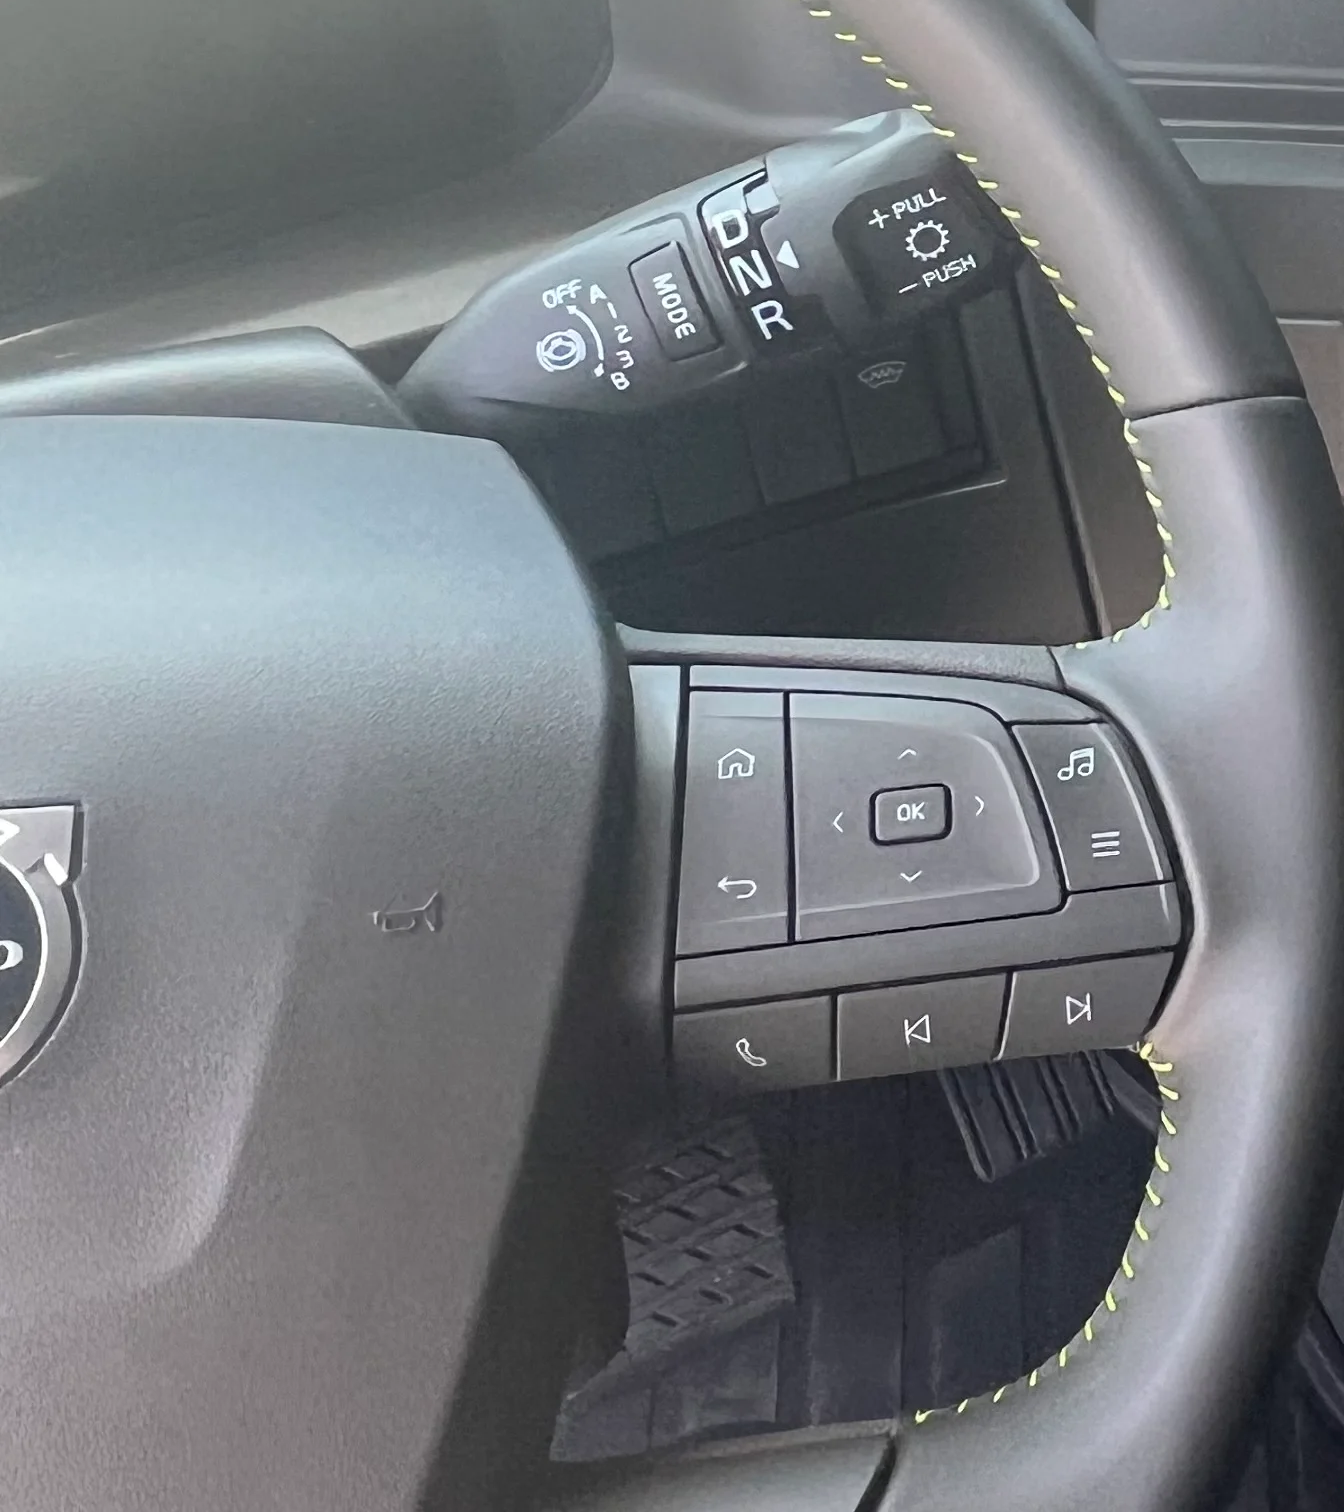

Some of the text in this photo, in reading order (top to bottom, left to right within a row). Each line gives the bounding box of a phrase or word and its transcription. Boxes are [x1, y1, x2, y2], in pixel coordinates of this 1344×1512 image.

[892, 188, 947, 220] PULL
[711, 208, 749, 249] D
[728, 249, 772, 296] N
[922, 254, 977, 288] PUSH
[542, 279, 582, 309] OFF
[590, 284, 607, 304] A
[652, 272, 697, 339] MODE
[614, 325, 633, 344] 2
[751, 300, 794, 340] R
[616, 350, 634, 369] 3
[610, 372, 630, 390] B
[896, 802, 926, 822] OK
